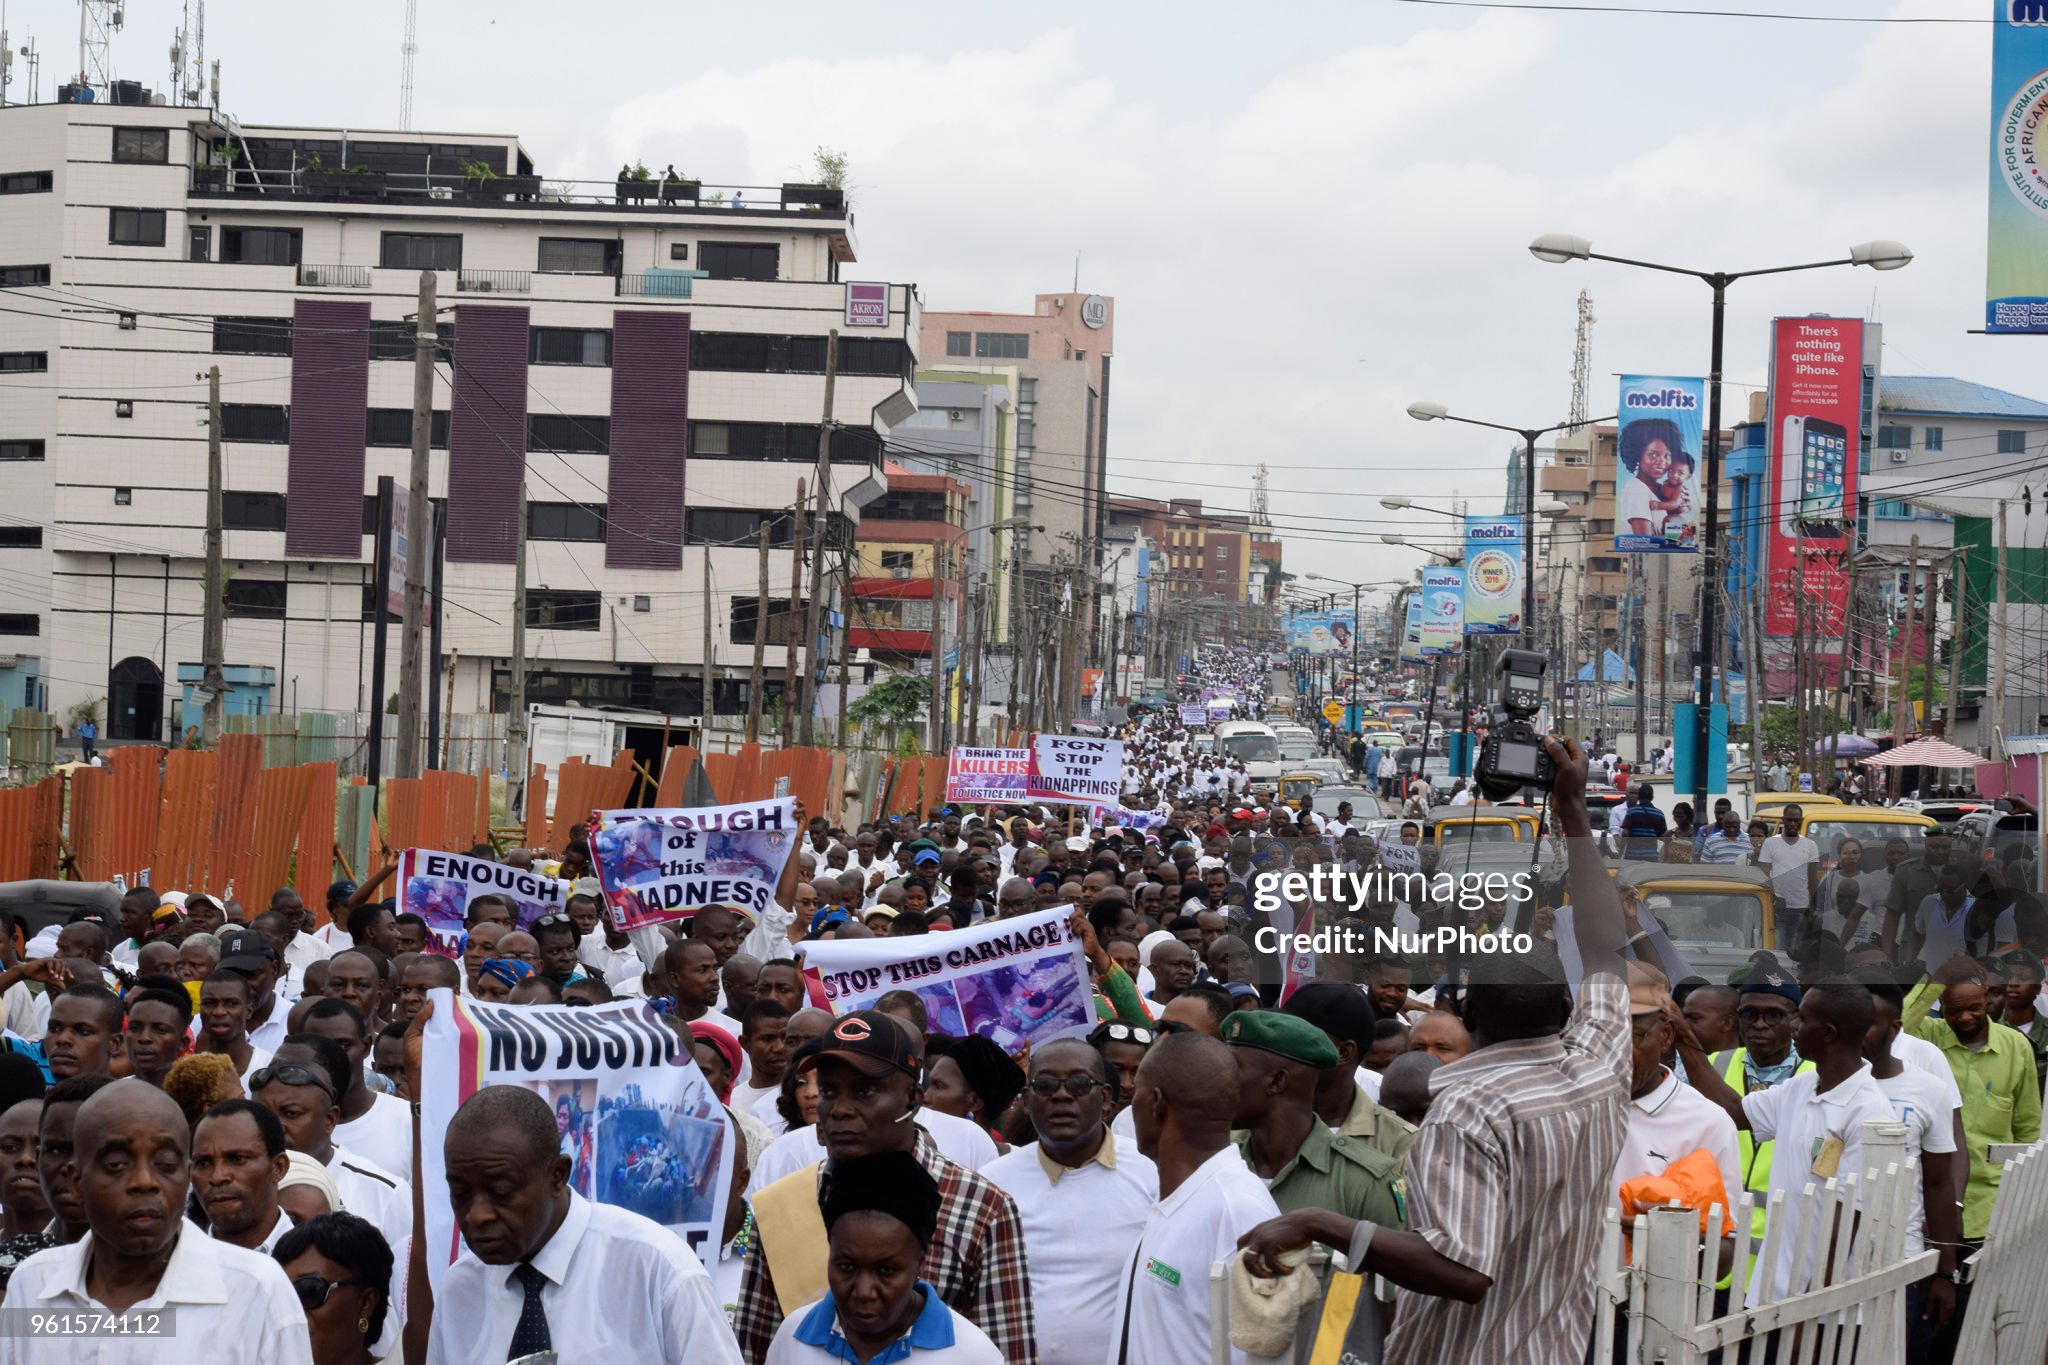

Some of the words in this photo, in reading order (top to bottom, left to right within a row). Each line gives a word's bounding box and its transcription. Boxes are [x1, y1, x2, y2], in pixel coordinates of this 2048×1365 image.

[2005, 146, 2019, 172] FOR
[853, 303, 882, 315] AKRON
[1996, 303, 2029, 315] Happy
[1996, 314, 2029, 327] Happy
[1799, 325, 1839, 336] There's
[1795, 340, 1841, 352] nothing
[1791, 352, 1821, 363] quite
[1823, 352, 1845, 362] like
[1796, 364, 1839, 376] iPhone.
[1627, 389, 1695, 408] molfix
[1471, 526, 1516, 539] molfix
[1483, 568, 1504, 576] WINNER
[1427, 577, 1461, 587] molfix
[966, 749, 1001, 758] BRING
[1006, 750, 1026, 759] THE
[1056, 753, 1103, 765] STOP
[960, 759, 1029, 775] KILLERS
[1064, 767, 1092, 777] THE
[1031, 776, 1118, 796] KIDNAPPINGS
[953, 788, 964, 798] TO
[966, 789, 1004, 800] JUSTICE
[668, 832, 699, 849] of
[660, 859, 705, 878] this
[426, 855, 560, 902] ENOUGH
[630, 880, 769, 917] MADNESS
[822, 967, 882, 1001] STOP
[886, 955, 943, 984] THIS
[946, 920, 1062, 969] CARNAGE
[468, 1003, 549, 1072] NO
